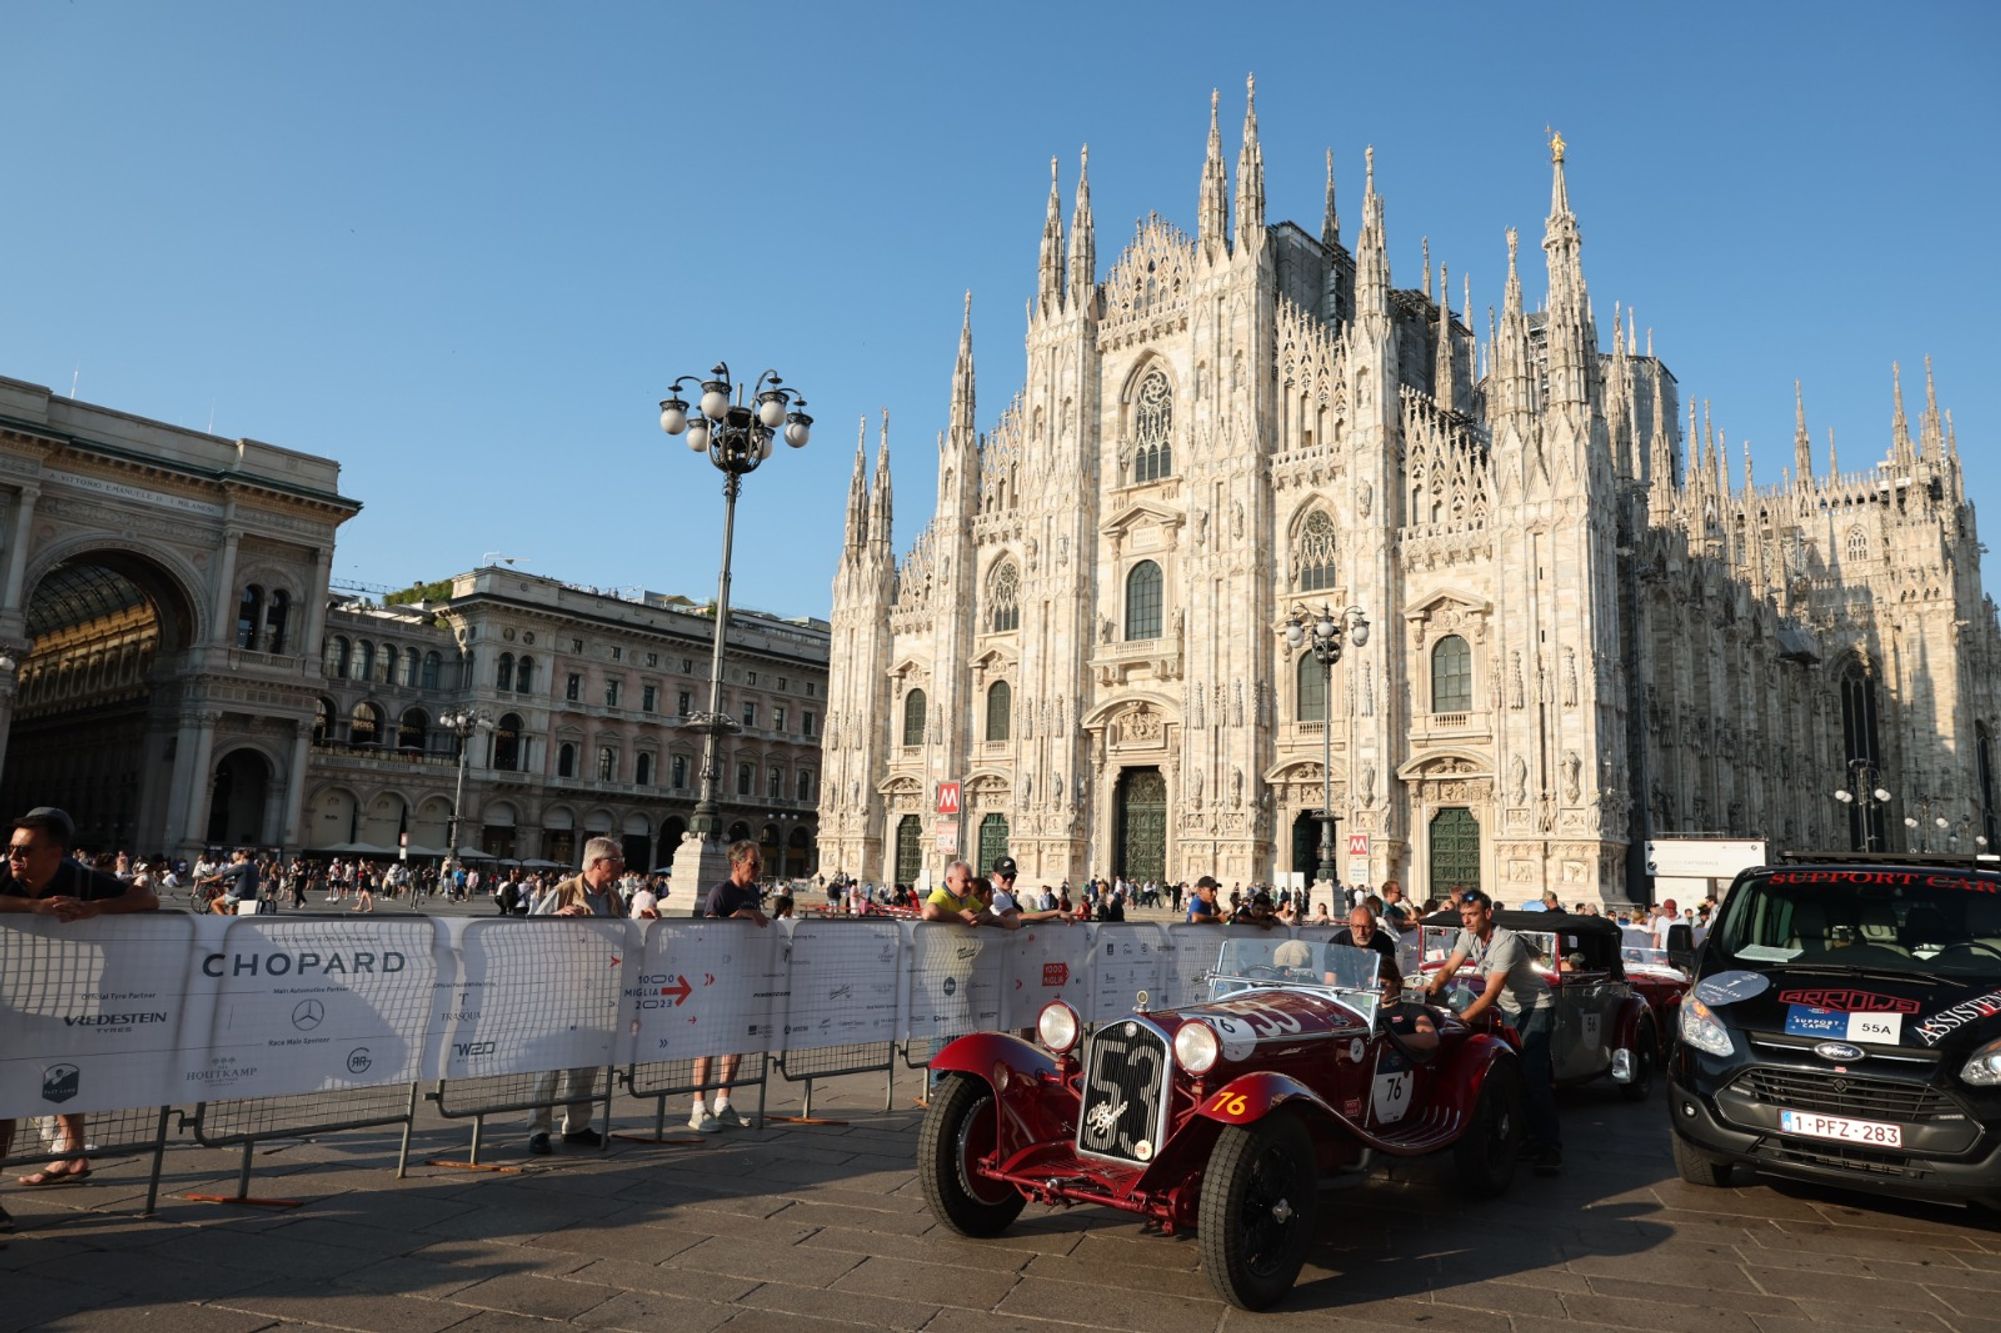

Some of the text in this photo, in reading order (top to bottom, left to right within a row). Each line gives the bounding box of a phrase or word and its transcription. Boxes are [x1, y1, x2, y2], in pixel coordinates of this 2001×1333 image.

[940, 788, 957, 808] M
[1350, 838, 1367, 851] M
[1768, 871, 1997, 894] SUPPORT CAR
[202, 951, 406, 978] CHOPARD
[128, 992, 156, 1000] Partner
[624, 987, 659, 998] MIGLIA
[1778, 989, 1920, 1015] ARROWS
[64, 1012, 167, 1027] VREDESTEIN
[1861, 1023, 1892, 1035] 55A
[186, 1067, 258, 1081] HOUTKAMP
[1386, 1077, 1402, 1102] 76
[1212, 1091, 1248, 1116] 76
